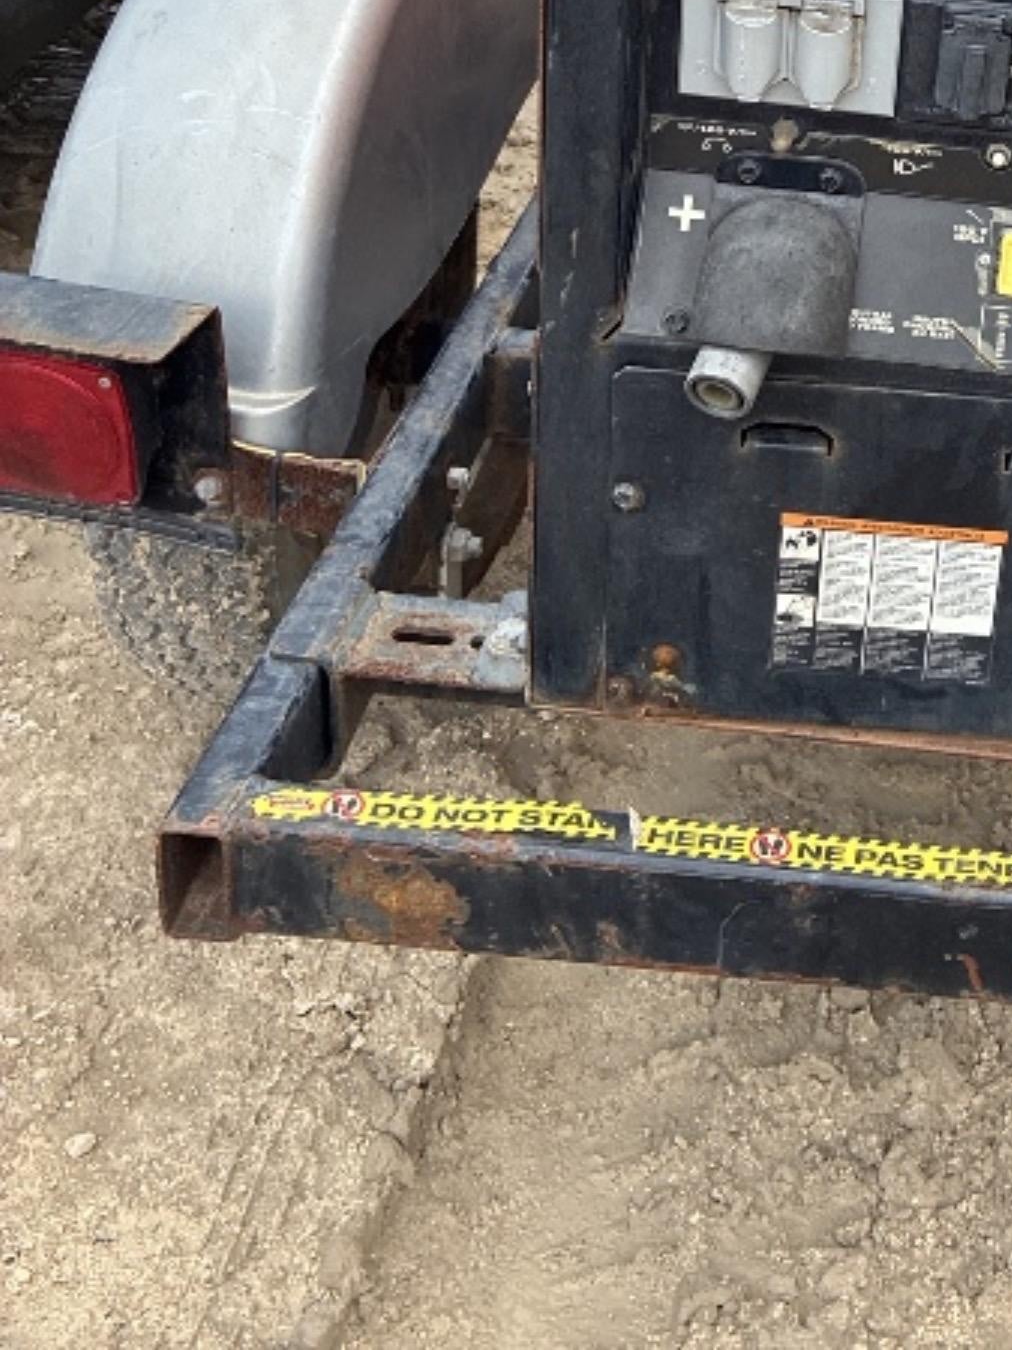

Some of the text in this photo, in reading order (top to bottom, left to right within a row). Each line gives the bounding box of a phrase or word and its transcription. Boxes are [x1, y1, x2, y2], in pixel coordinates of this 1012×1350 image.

[369, 803, 426, 820] DO
[434, 808, 511, 824] NOT
[649, 828, 745, 851] HERE
[797, 842, 845, 862] NE
[855, 848, 925, 871] PAS
